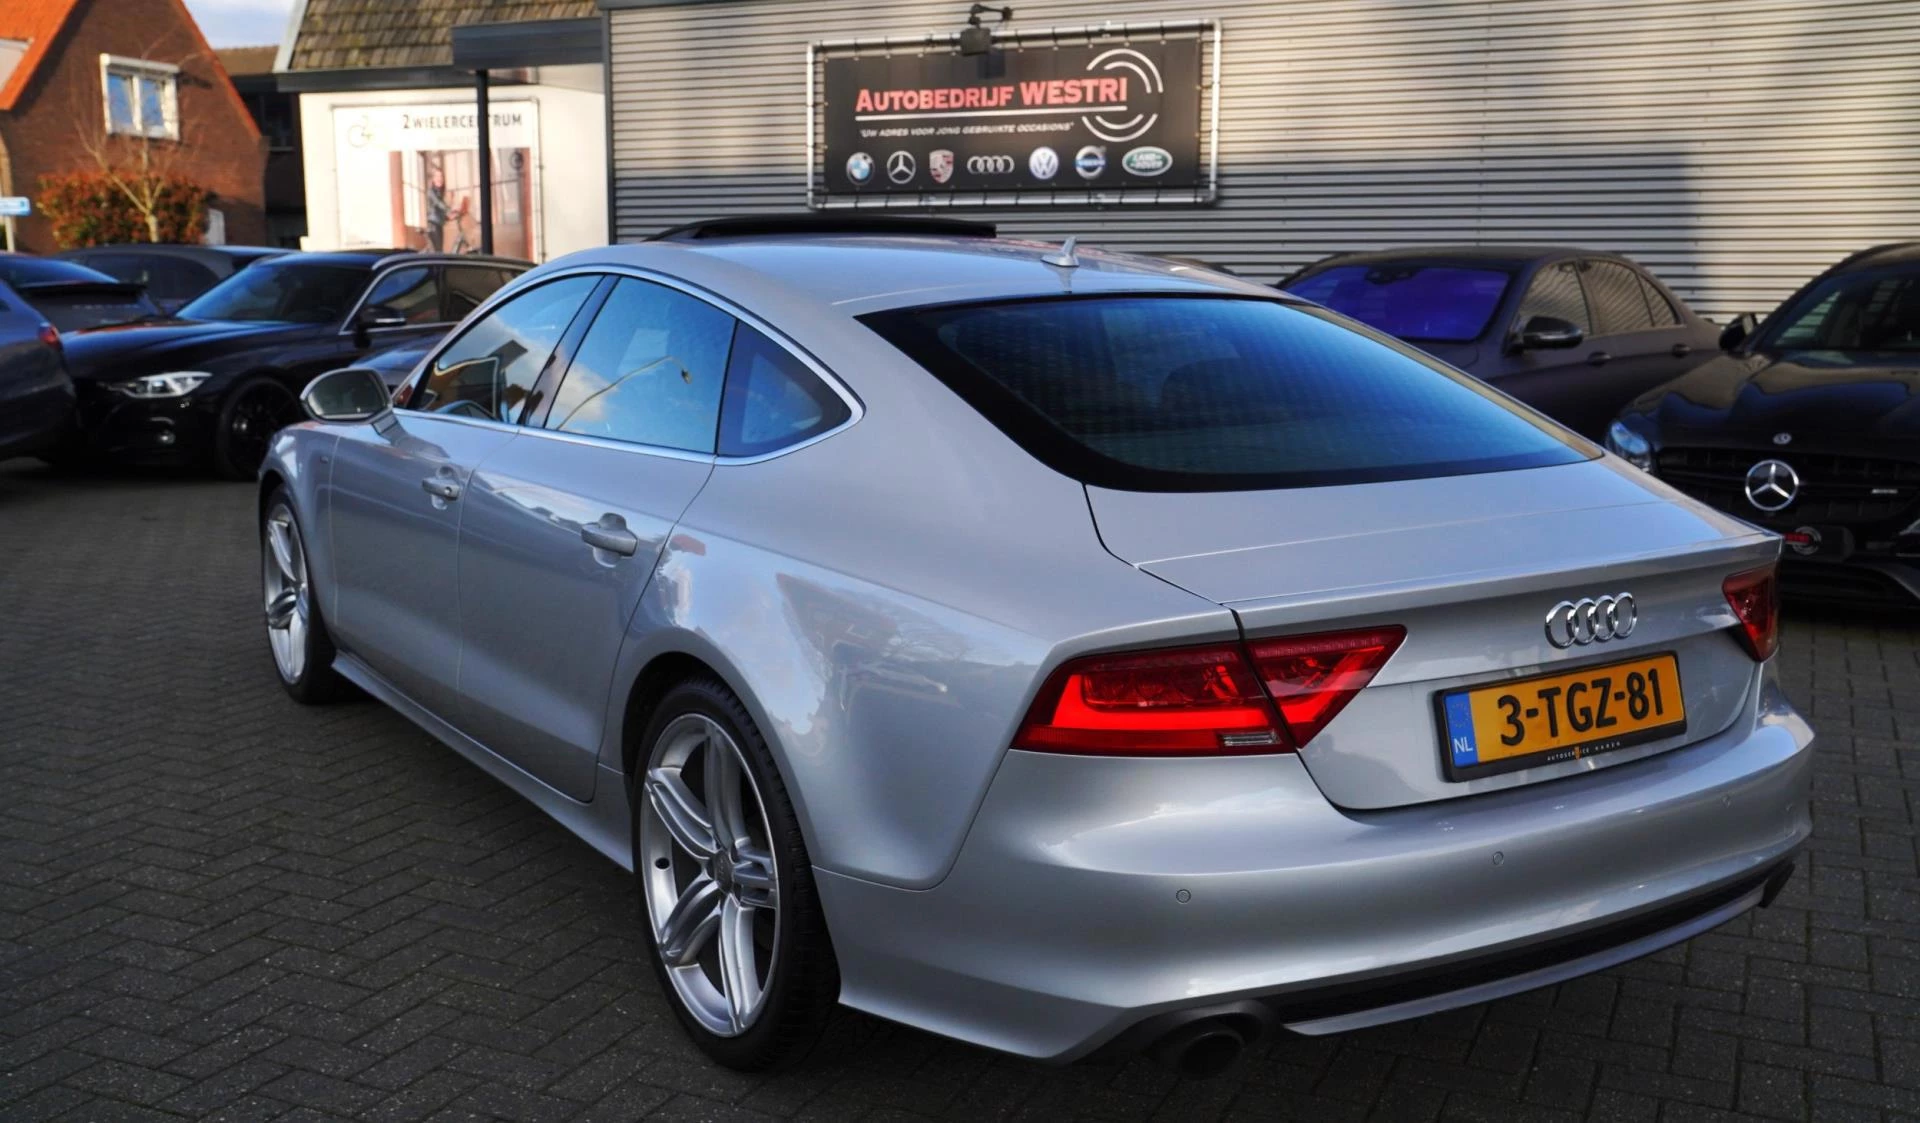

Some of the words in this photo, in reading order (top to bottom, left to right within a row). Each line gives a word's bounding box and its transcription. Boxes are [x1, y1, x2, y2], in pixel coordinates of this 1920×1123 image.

[855, 86, 1014, 112] AUTOBEDRIJF
[1020, 77, 1128, 106] WESTRI
[1497, 668, 1664, 747] 3-TGZ-81
[1453, 737, 1473, 754] NL
